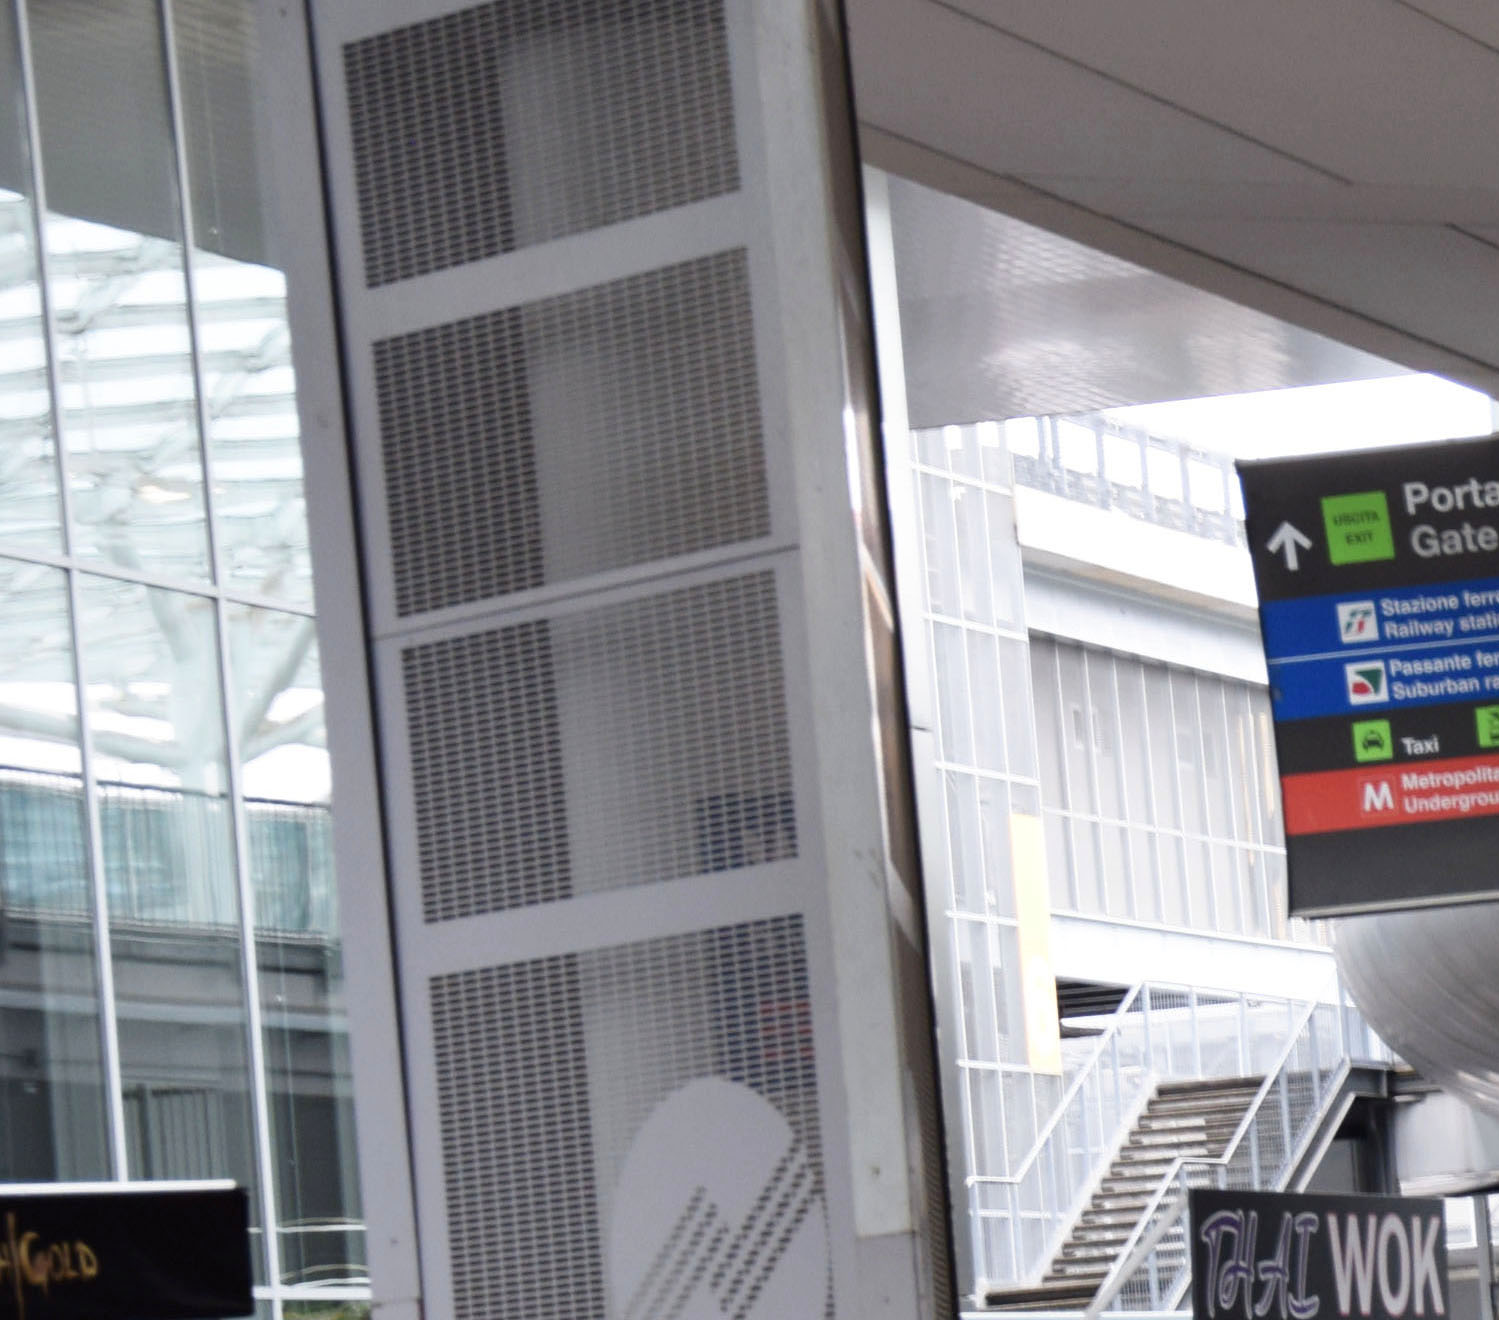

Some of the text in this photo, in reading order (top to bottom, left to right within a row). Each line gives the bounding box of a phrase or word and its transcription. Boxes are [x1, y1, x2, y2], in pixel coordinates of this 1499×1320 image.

[1410, 521, 1499, 559] Gate
[1381, 592, 1459, 618] Stazione
[1384, 614, 1454, 641] Railway
[1389, 655, 1471, 678] Passante
[1392, 676, 1480, 700] Suburban
[1402, 735, 1441, 755] Taxi
[1363, 781, 1395, 812] M
[18, 1231, 99, 1298] GOLD
[1325, 1212, 1446, 1318] WOK
